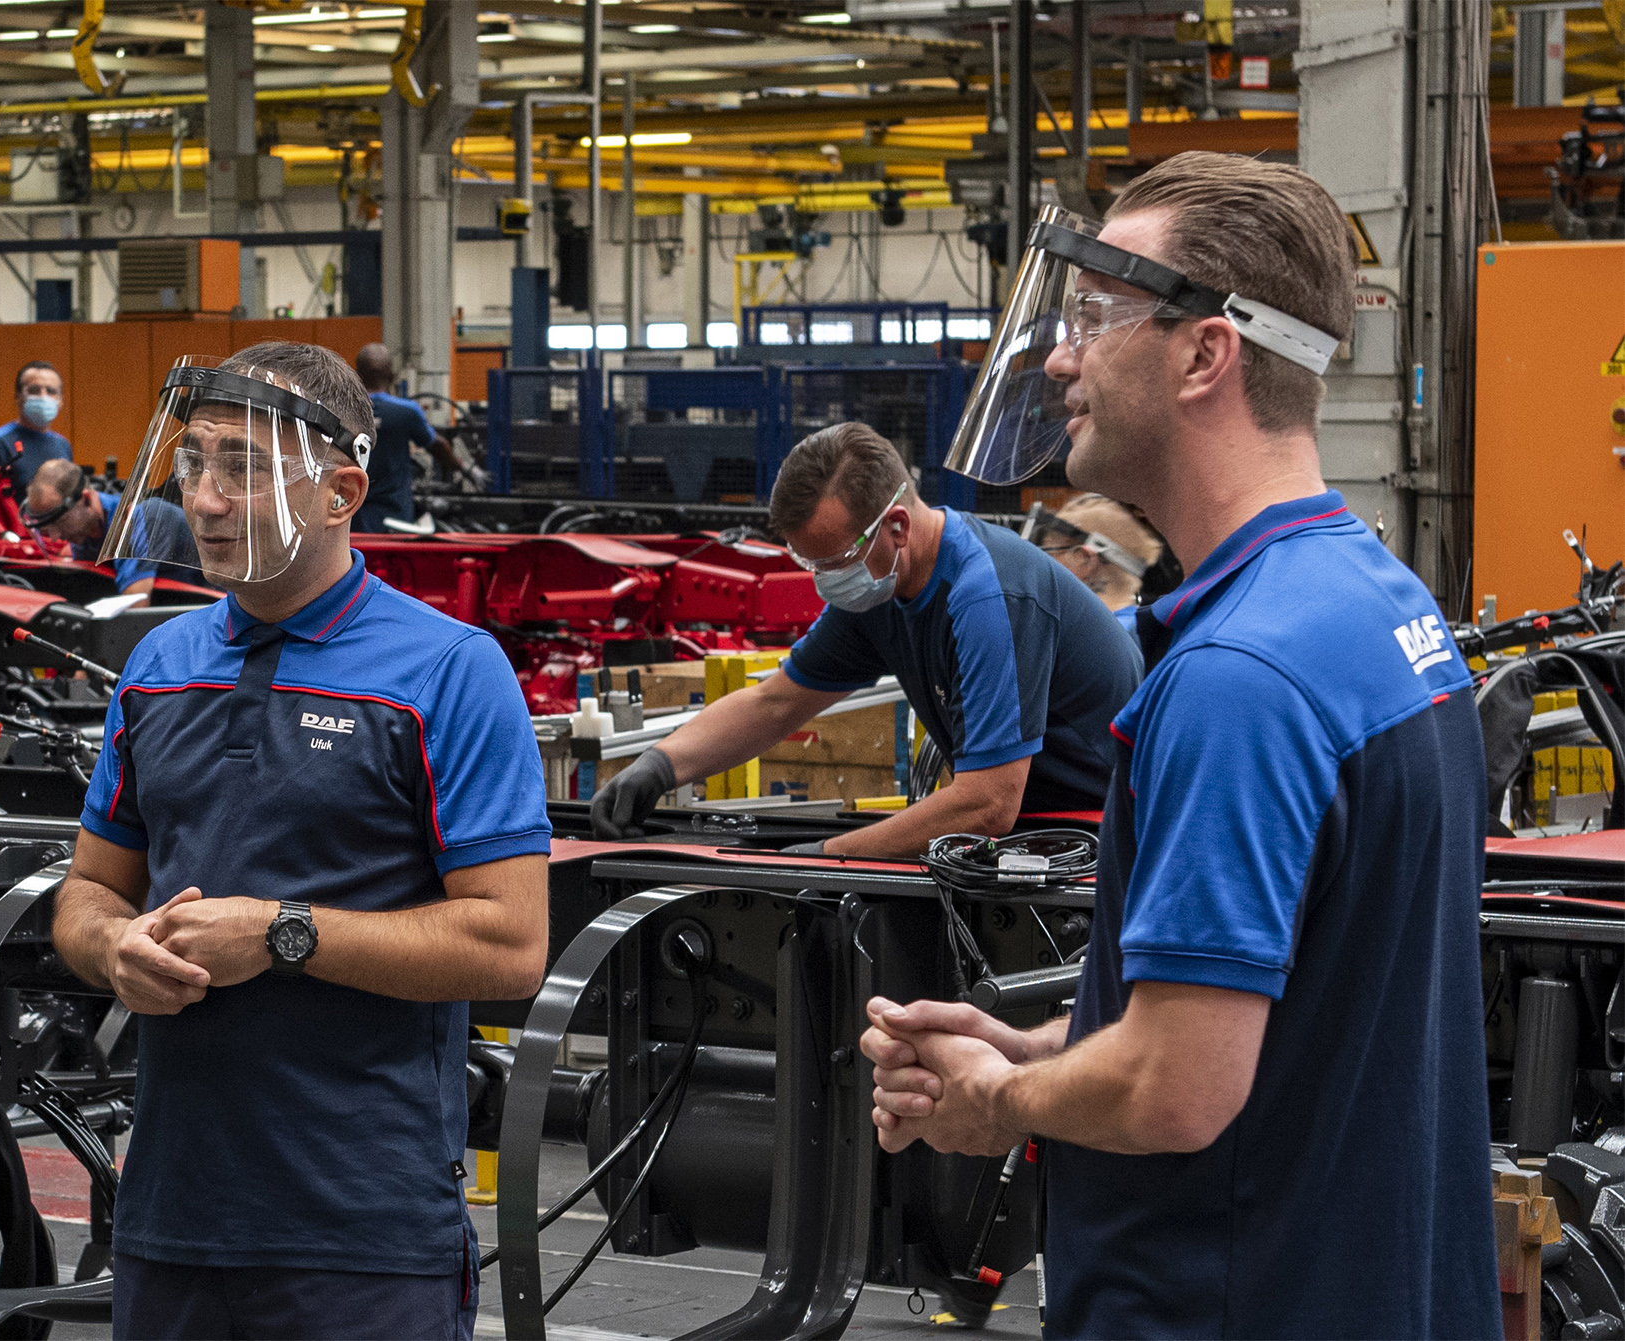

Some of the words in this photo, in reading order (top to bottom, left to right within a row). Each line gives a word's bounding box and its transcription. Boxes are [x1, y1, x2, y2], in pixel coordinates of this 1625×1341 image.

[1393, 614, 1446, 664] DAF
[301, 712, 355, 730] DAF
[311, 737, 333, 751] Ufuk
